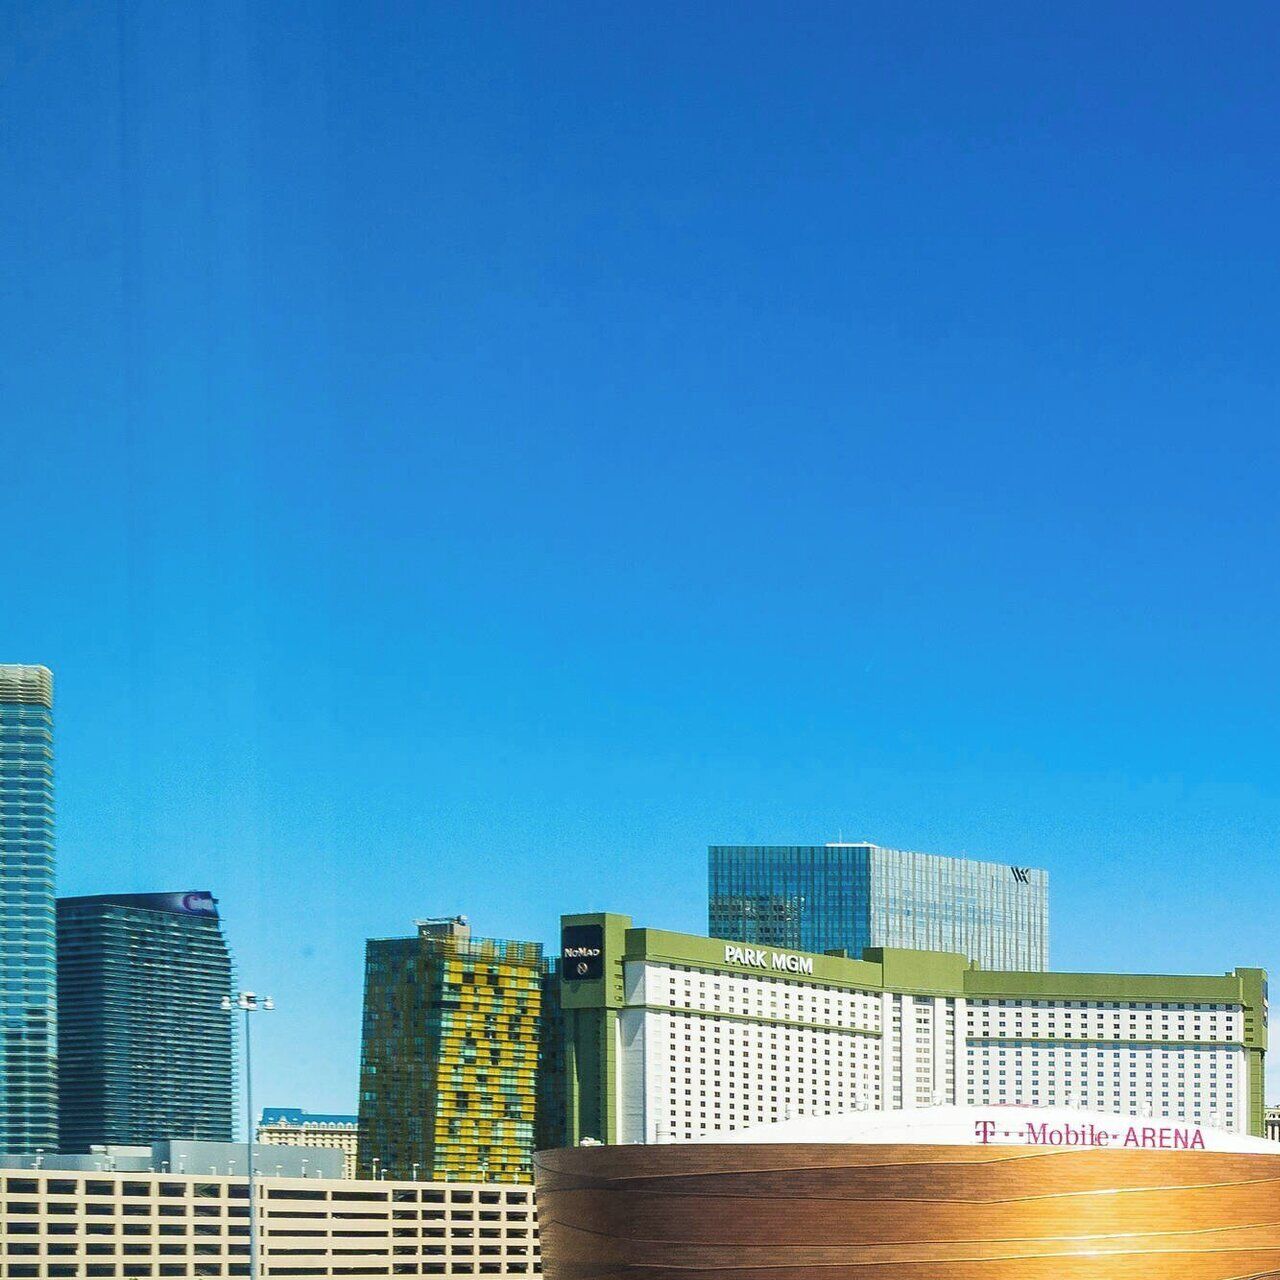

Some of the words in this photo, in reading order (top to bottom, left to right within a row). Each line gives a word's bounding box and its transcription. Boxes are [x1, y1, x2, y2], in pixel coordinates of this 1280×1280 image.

[724, 945, 767, 968] PARK
[771, 953, 813, 975] MGM
[1123, 1126, 1206, 1150] ARENA
